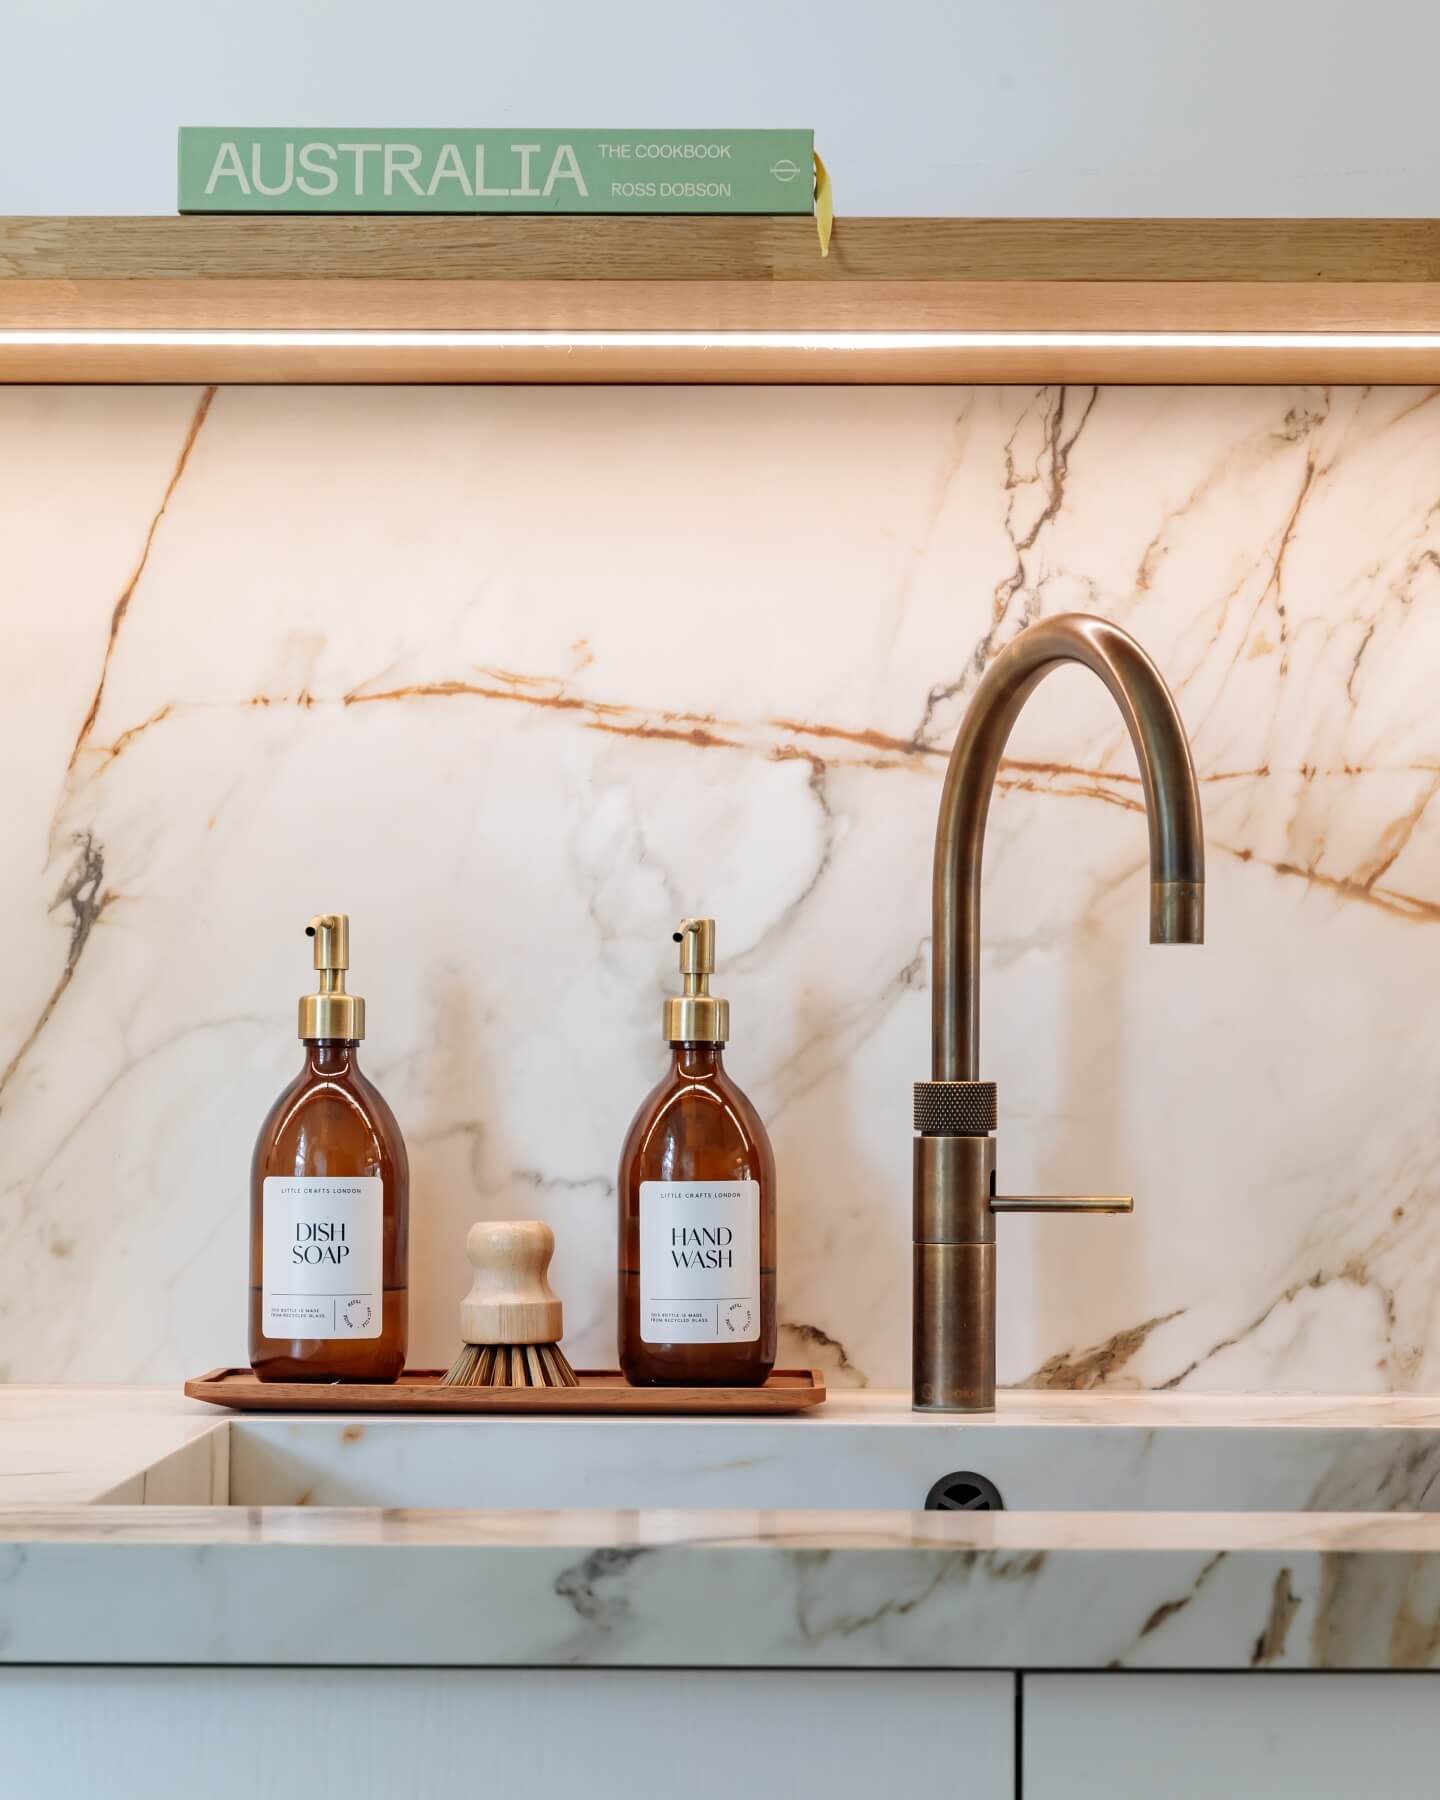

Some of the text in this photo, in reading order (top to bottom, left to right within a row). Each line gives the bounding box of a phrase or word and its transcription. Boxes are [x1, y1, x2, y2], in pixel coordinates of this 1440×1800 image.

[598, 144, 732, 159] THE COOKBOOK
[204, 142, 589, 197] AUSTRALIA
[611, 182, 731, 197] ROSS DOBSON
[296, 1222, 345, 1241] DISH
[672, 1227, 732, 1246] HAND
[292, 1245, 350, 1264] SOAP
[671, 1249, 732, 1269] WASH
